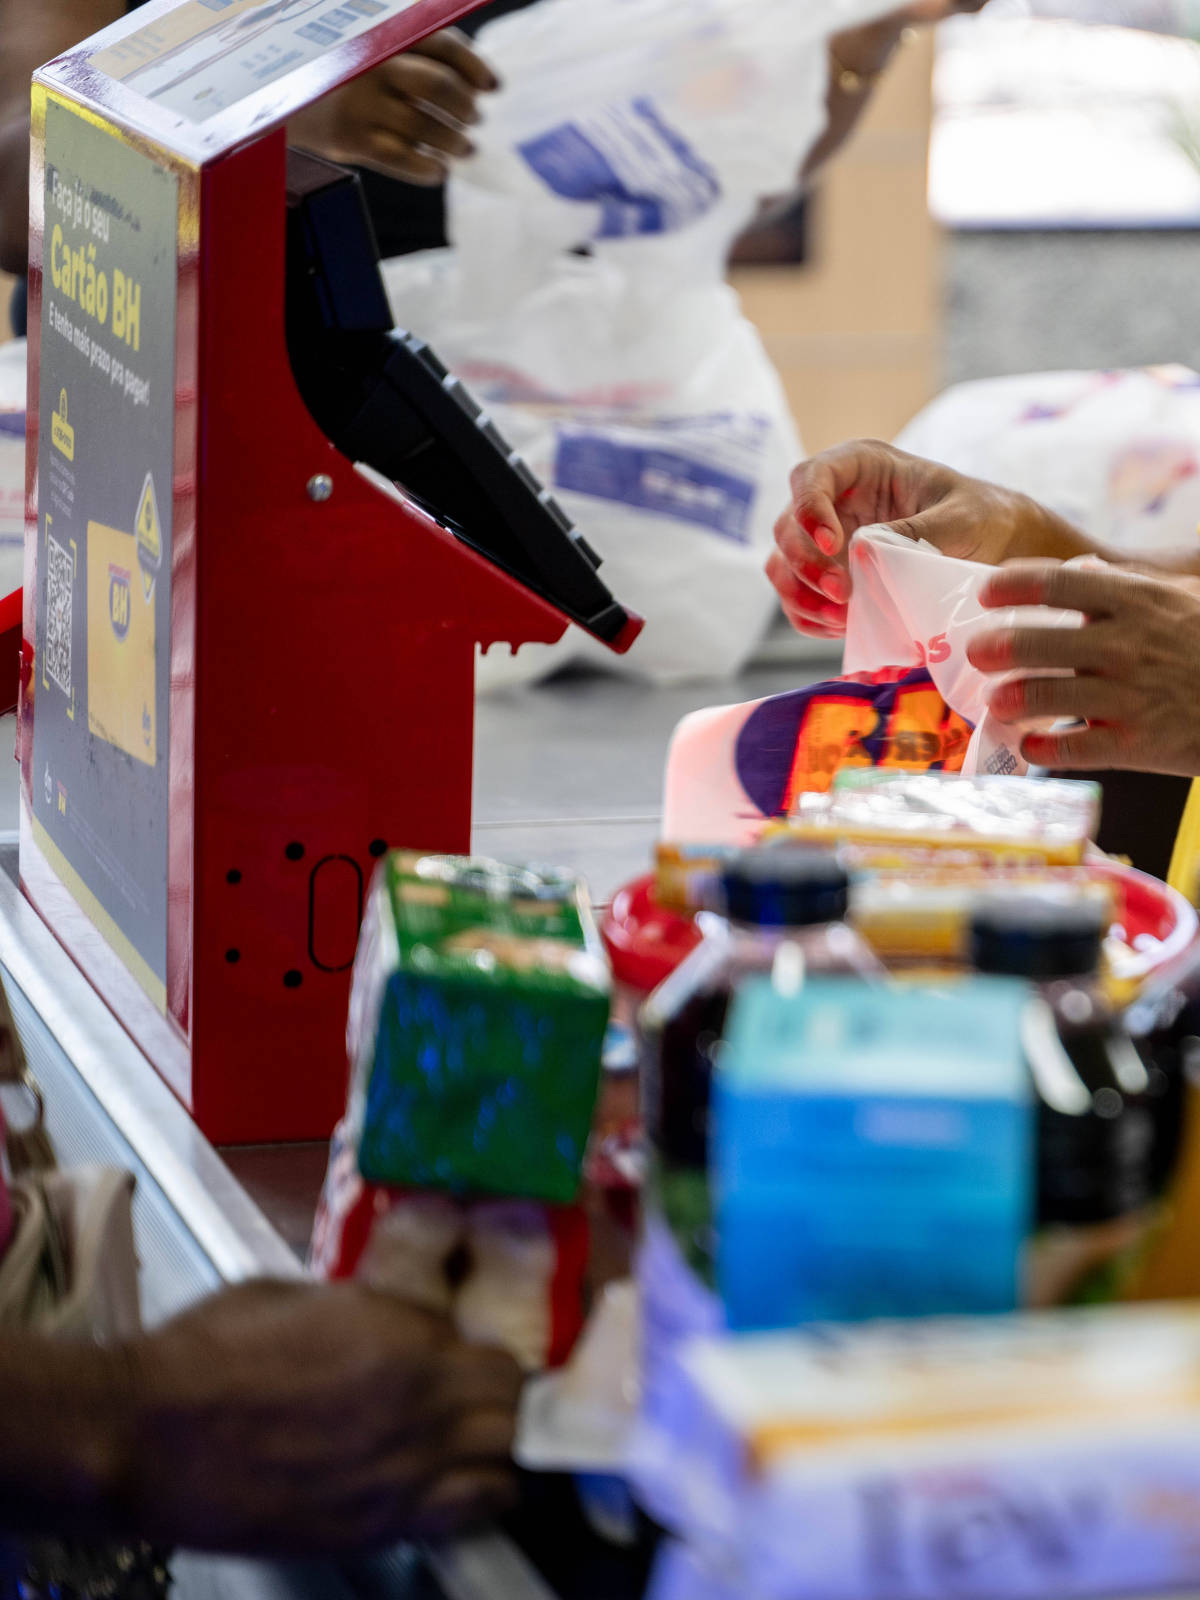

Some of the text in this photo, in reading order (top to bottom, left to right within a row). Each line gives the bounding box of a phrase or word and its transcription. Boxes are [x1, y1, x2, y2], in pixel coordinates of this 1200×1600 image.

[52, 170, 72, 223] Faça
[84, 201, 90, 229] o
[92, 206, 110, 243] seu
[51, 224, 142, 352] Cartão BH
[49, 302, 54, 327] E
[54, 306, 73, 343] tenha
[73, 326, 90, 358] mais
[90, 340, 110, 375] prazo
[111, 357, 124, 386] pra
